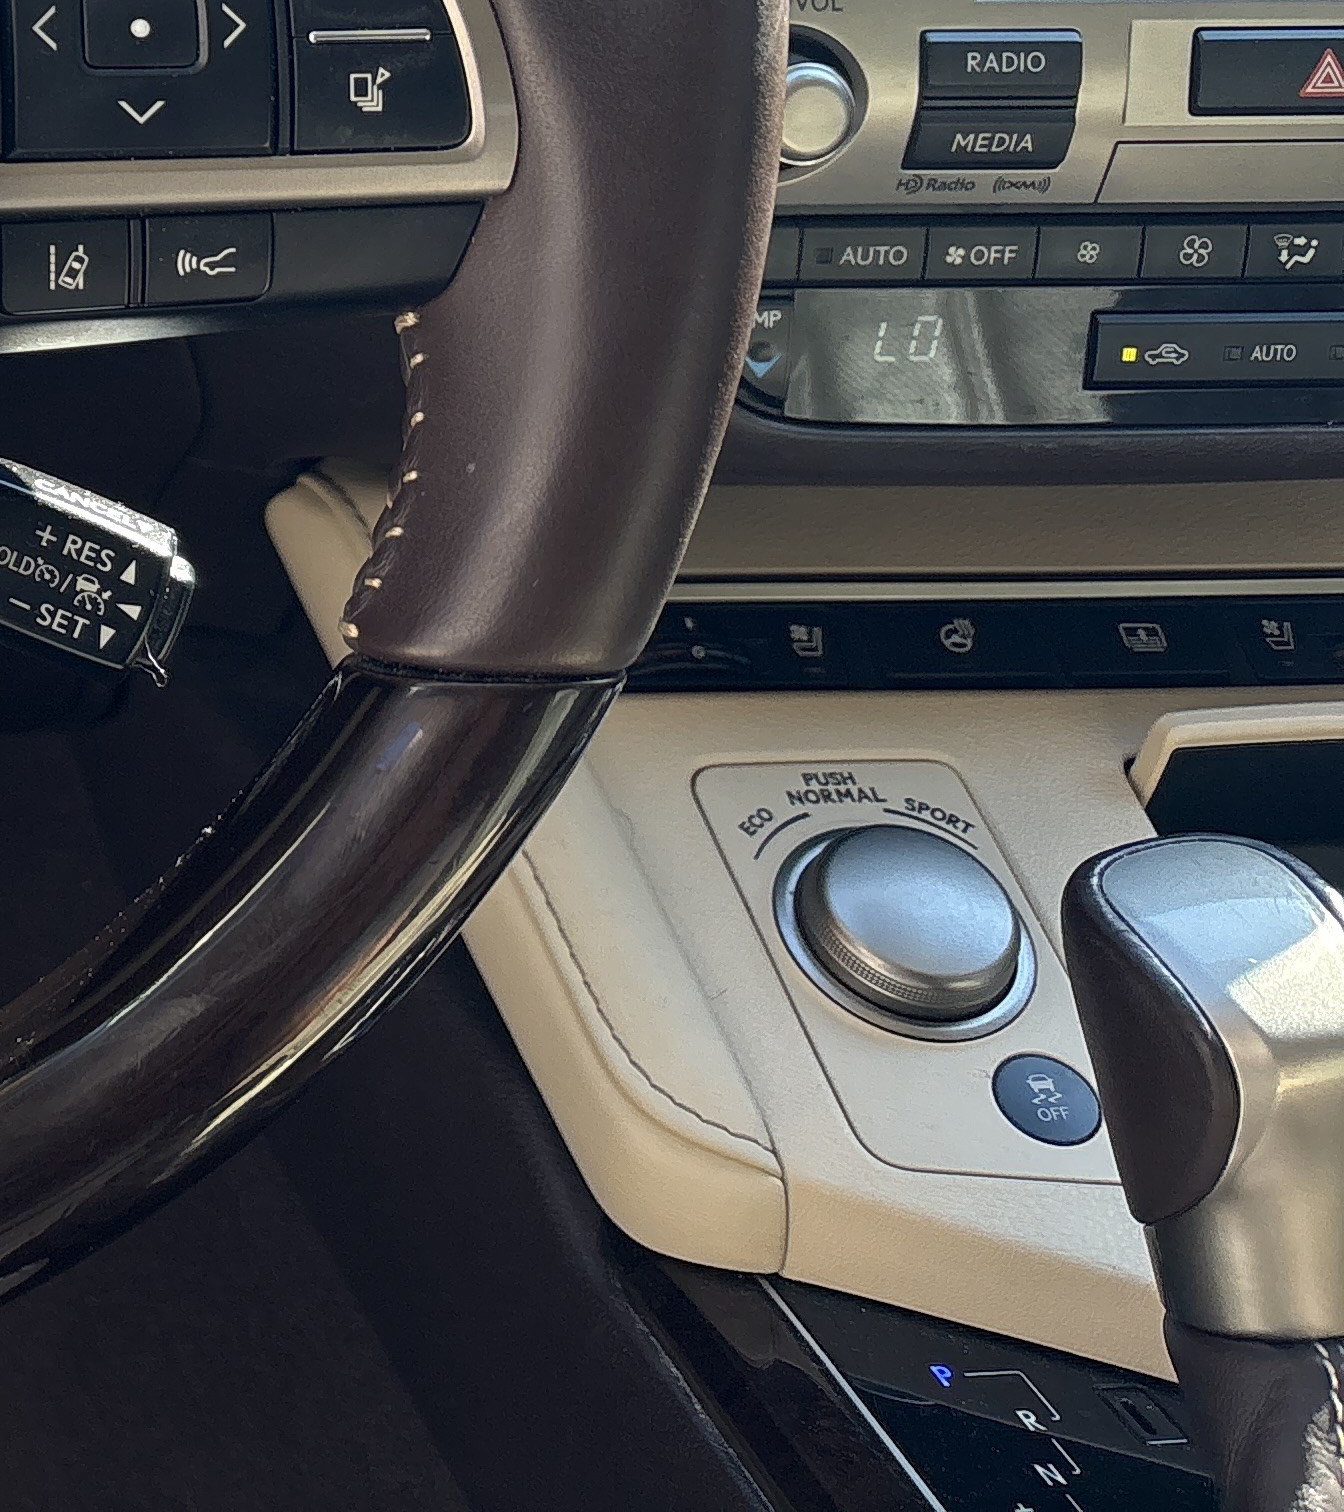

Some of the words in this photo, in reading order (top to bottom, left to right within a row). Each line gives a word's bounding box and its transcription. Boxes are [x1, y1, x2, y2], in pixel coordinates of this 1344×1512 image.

[966, 51, 1047, 74] RADIO
[951, 132, 1034, 154] MEDIA
[925, 176, 977, 192] Radio
[839, 246, 908, 267] AUTO
[970, 245, 1019, 267] OFF
[1250, 345, 1297, 362] AUTO
[62, 533, 116, 573] RES
[35, 602, 90, 639] SET
[801, 771, 857, 787] PUSH
[738, 807, 775, 838] ECO
[785, 787, 888, 807] NORMAL
[903, 797, 975, 835] SPORT
[1037, 1105, 1070, 1122] OFF
[929, 1363, 954, 1388] P
[1015, 1409, 1048, 1432] R
[1032, 1462, 1068, 1487] N
